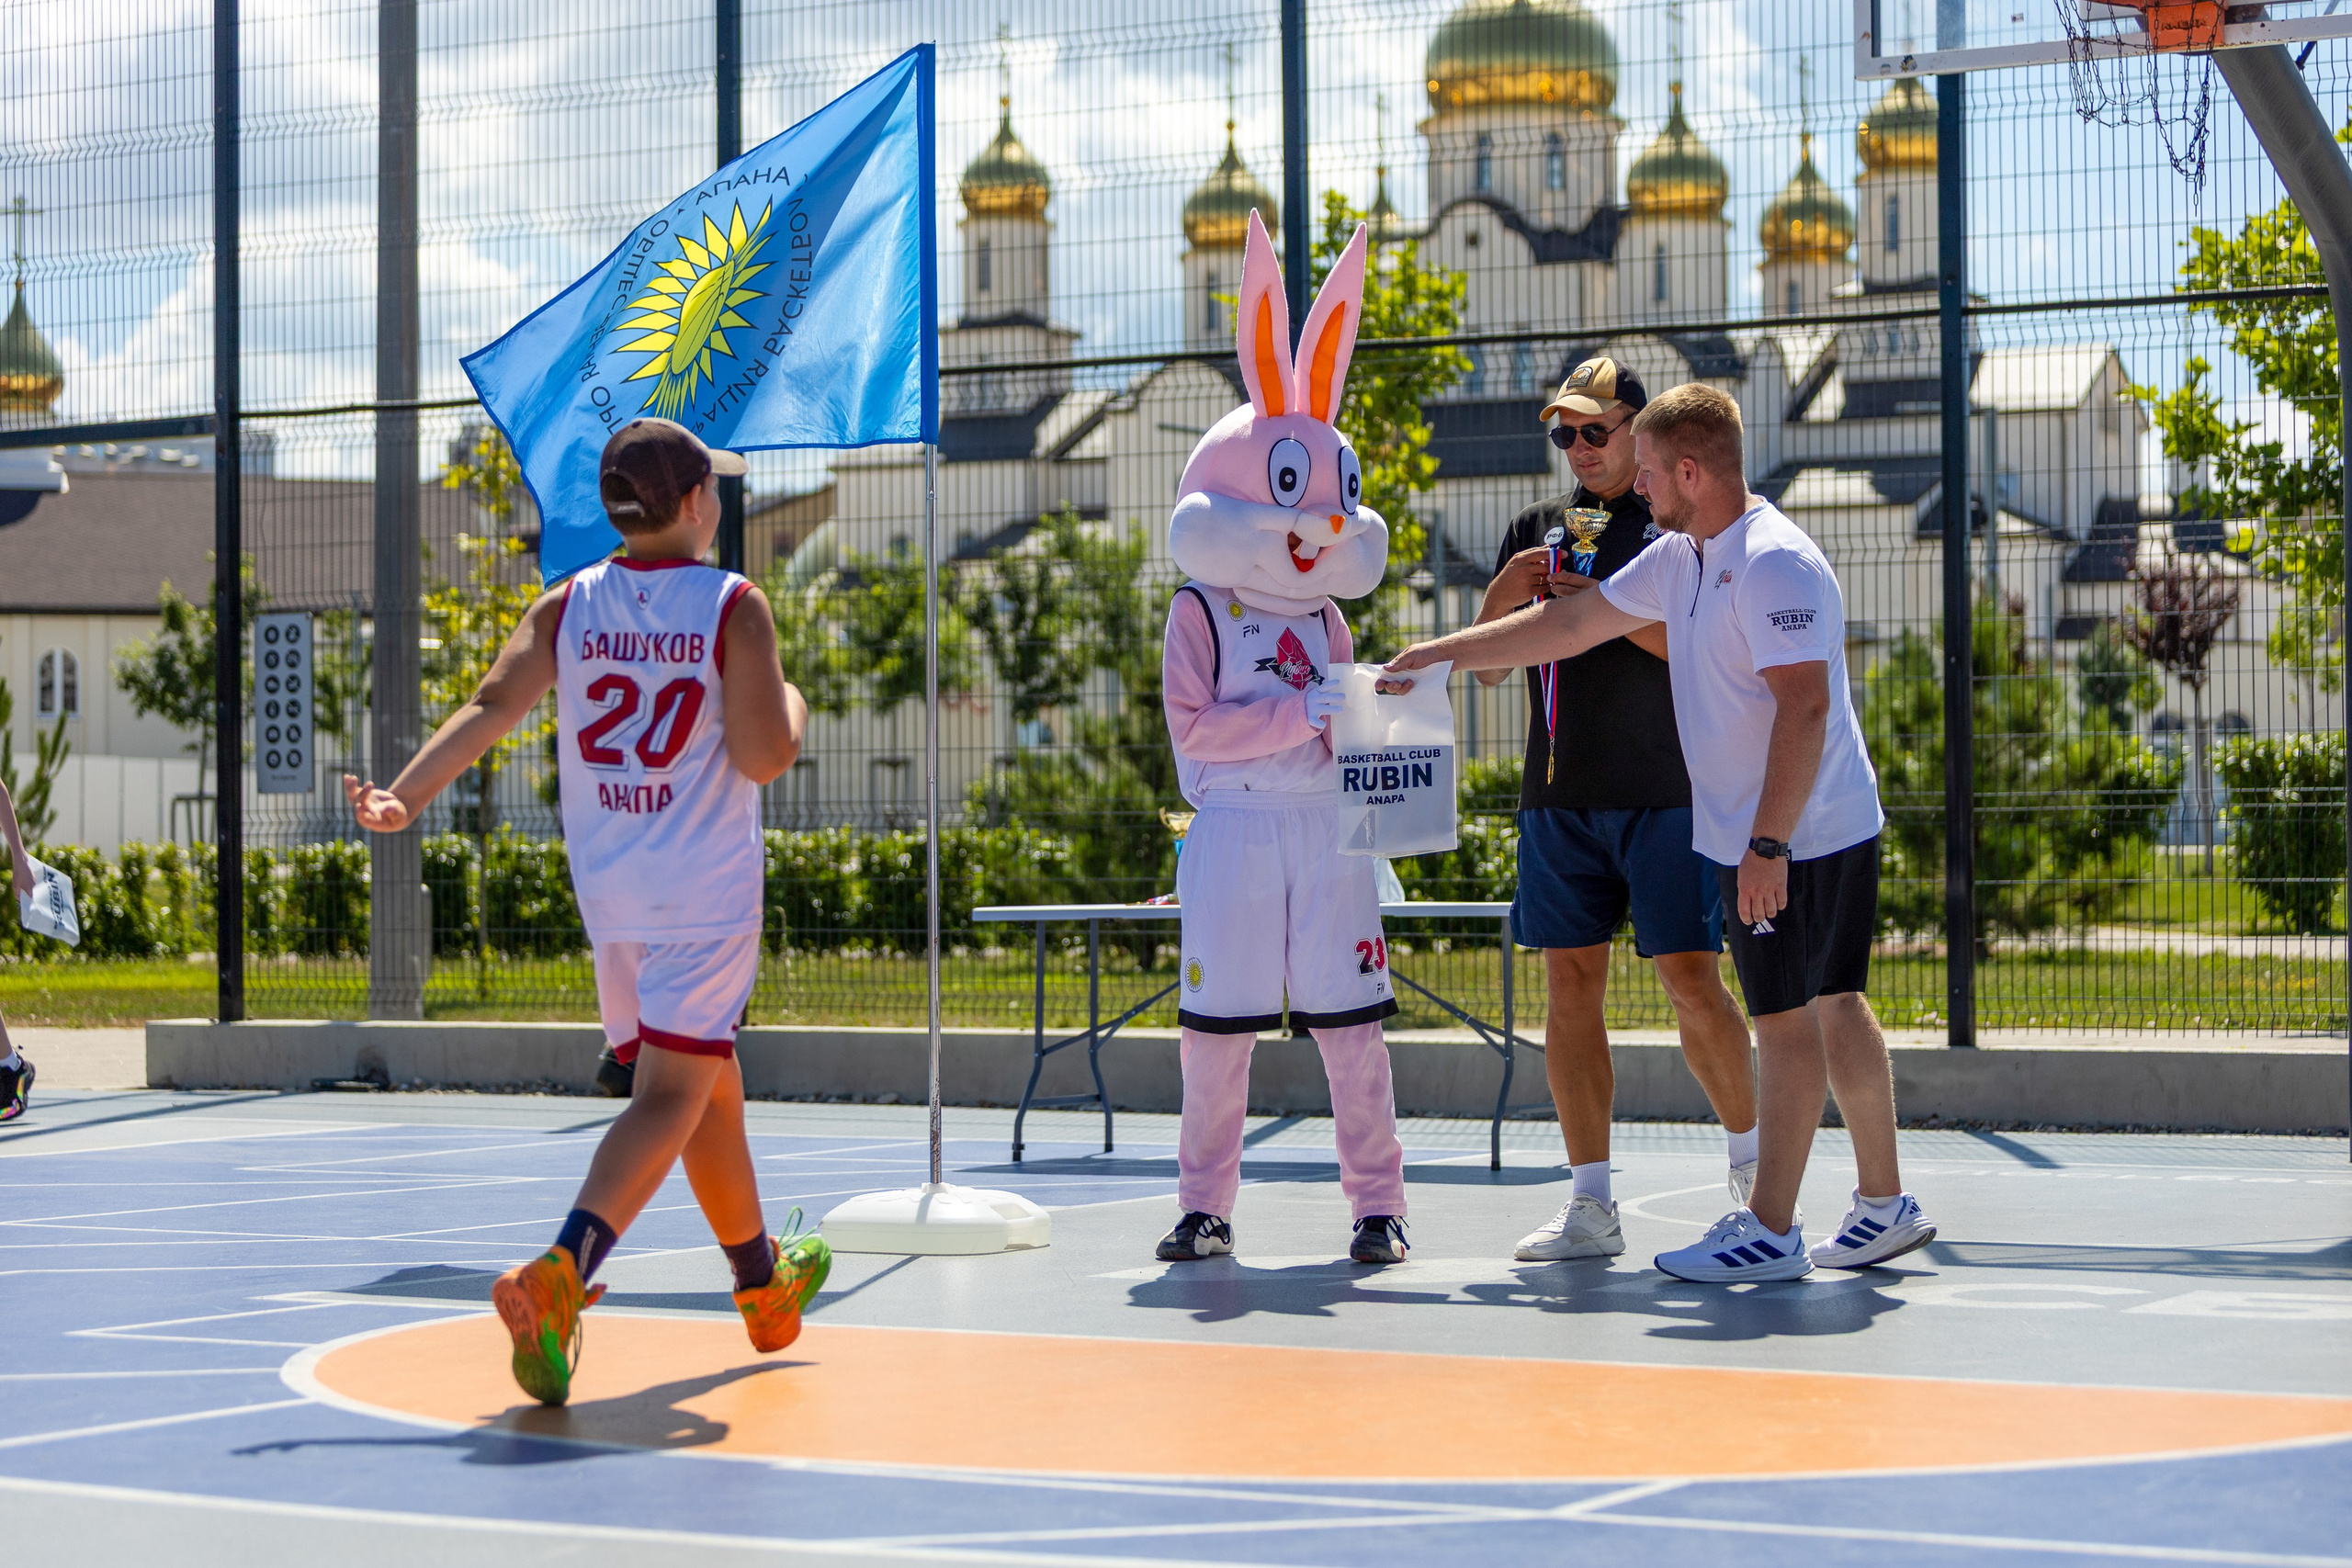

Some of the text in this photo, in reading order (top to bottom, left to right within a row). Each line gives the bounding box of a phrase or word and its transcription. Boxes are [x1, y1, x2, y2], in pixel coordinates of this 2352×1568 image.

[1766, 608, 1804, 618] BASKETBALL
[1770, 613, 1815, 626] RUBIN
[1242, 624, 1261, 638] FN
[1781, 623, 1808, 632] ANAPA
[582, 629, 706, 664] БАШУКОВ
[577, 672, 707, 772] 20
[1338, 748, 1442, 764] BASKETBALL CLUB
[1343, 762, 1433, 793] RUBIN
[1365, 794, 1406, 806] ANAPA
[1353, 934, 1388, 976] 23
